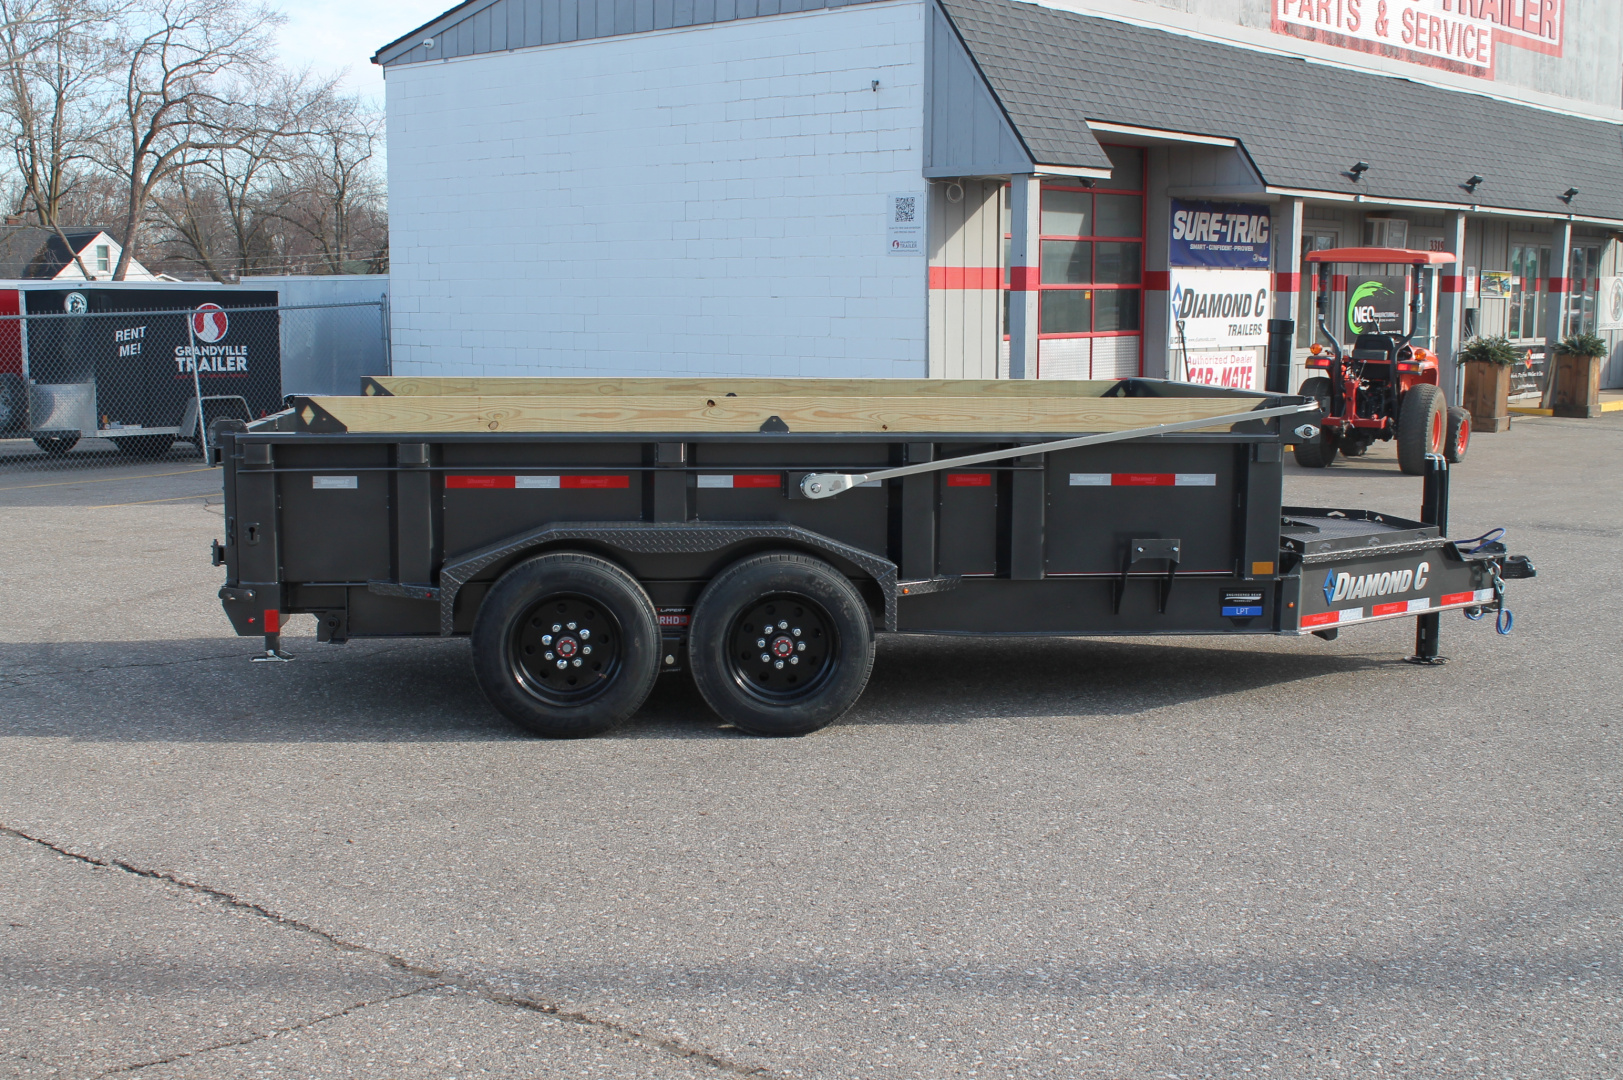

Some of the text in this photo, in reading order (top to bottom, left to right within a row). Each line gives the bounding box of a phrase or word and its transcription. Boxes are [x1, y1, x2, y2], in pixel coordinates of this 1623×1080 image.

[1443, 0, 1556, 40] ILER
[1375, 0, 1390, 37] &
[1401, 7, 1490, 63] SERVICE
[1173, 211, 1269, 243] SURE-TRAC
[1180, 287, 1267, 318] DIAMOND C
[1354, 305, 1375, 323] NEO
[115, 326, 147, 343] RENT
[1228, 323, 1263, 337] TRAILERS
[119, 342, 141, 357] ME!
[174, 346, 248, 356] GRANDVILLE
[175, 356, 248, 372] TRAILER
[1187, 354, 1253, 366] Authorized Dealer
[1221, 366, 1253, 389] MATE
[1333, 561, 1429, 601] DIAMOND C
[1236, 607, 1250, 615] LPT
[659, 616, 680, 625] RHD
